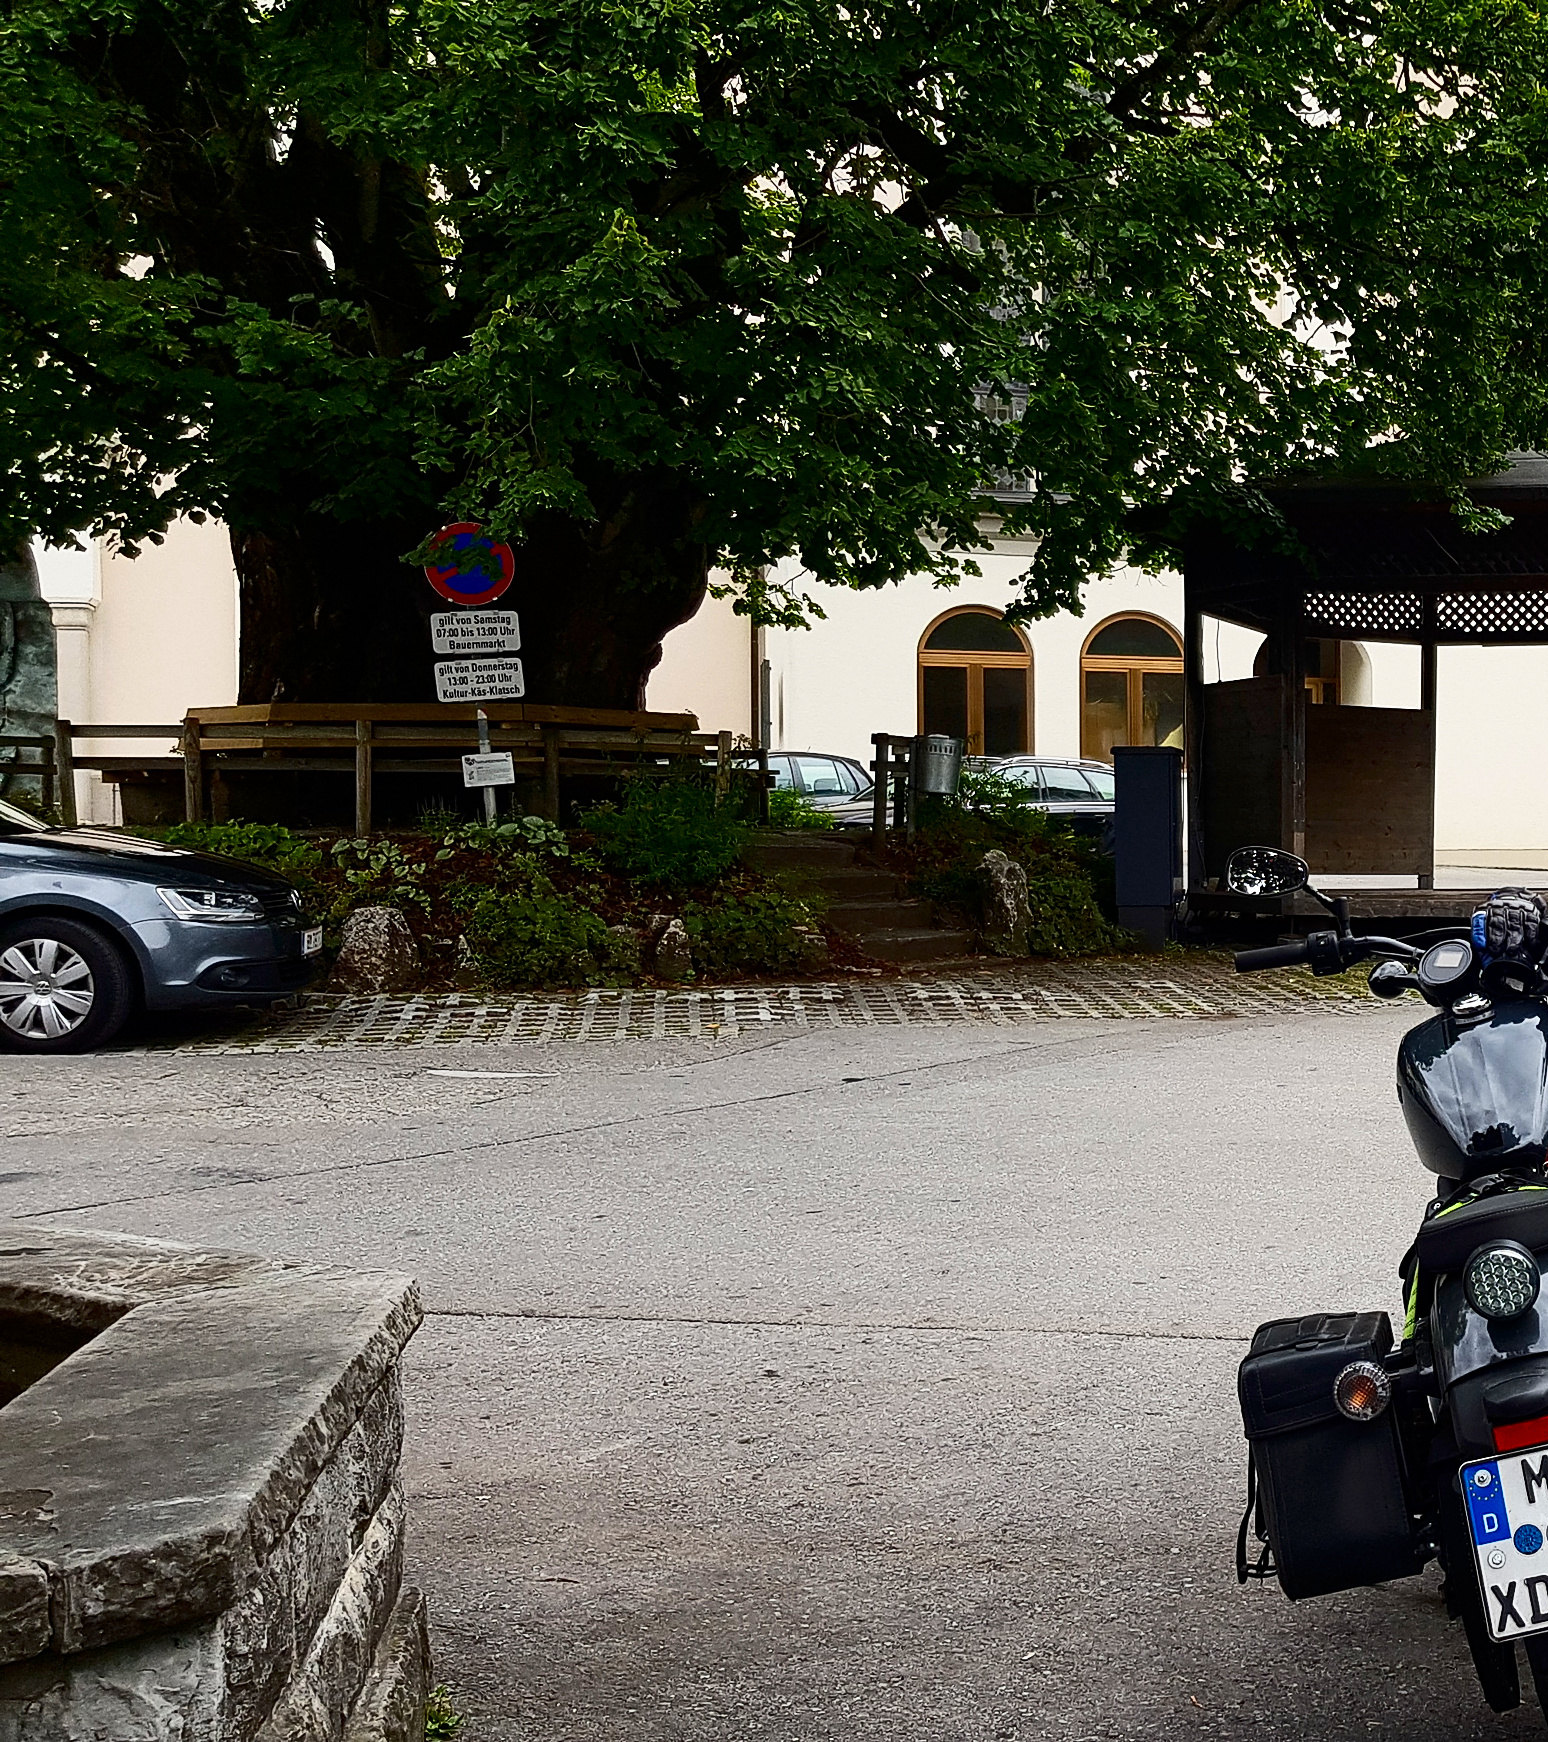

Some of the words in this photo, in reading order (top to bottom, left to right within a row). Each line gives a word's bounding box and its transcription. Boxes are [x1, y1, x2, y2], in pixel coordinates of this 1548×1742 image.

[439, 616, 454, 627] gilt
[456, 617, 471, 625] von
[473, 615, 511, 625] Samstag
[436, 628, 459, 638] 07:00
[461, 628, 474, 637] bis
[476, 627, 498, 637] 13:00
[500, 626, 515, 636] Uhr
[449, 639, 506, 650] Bauernmarkt
[439, 665, 453, 676] gilt
[454, 666, 470, 674] von
[471, 662, 518, 673] Donnerstag
[447, 676, 469, 686] 13:00
[475, 674, 497, 685] 23:00
[498, 673, 512, 682] Uhr
[443, 684, 520, 699] Kultur-Käs-Klatsch
[1482, 1513, 1499, 1533] D
